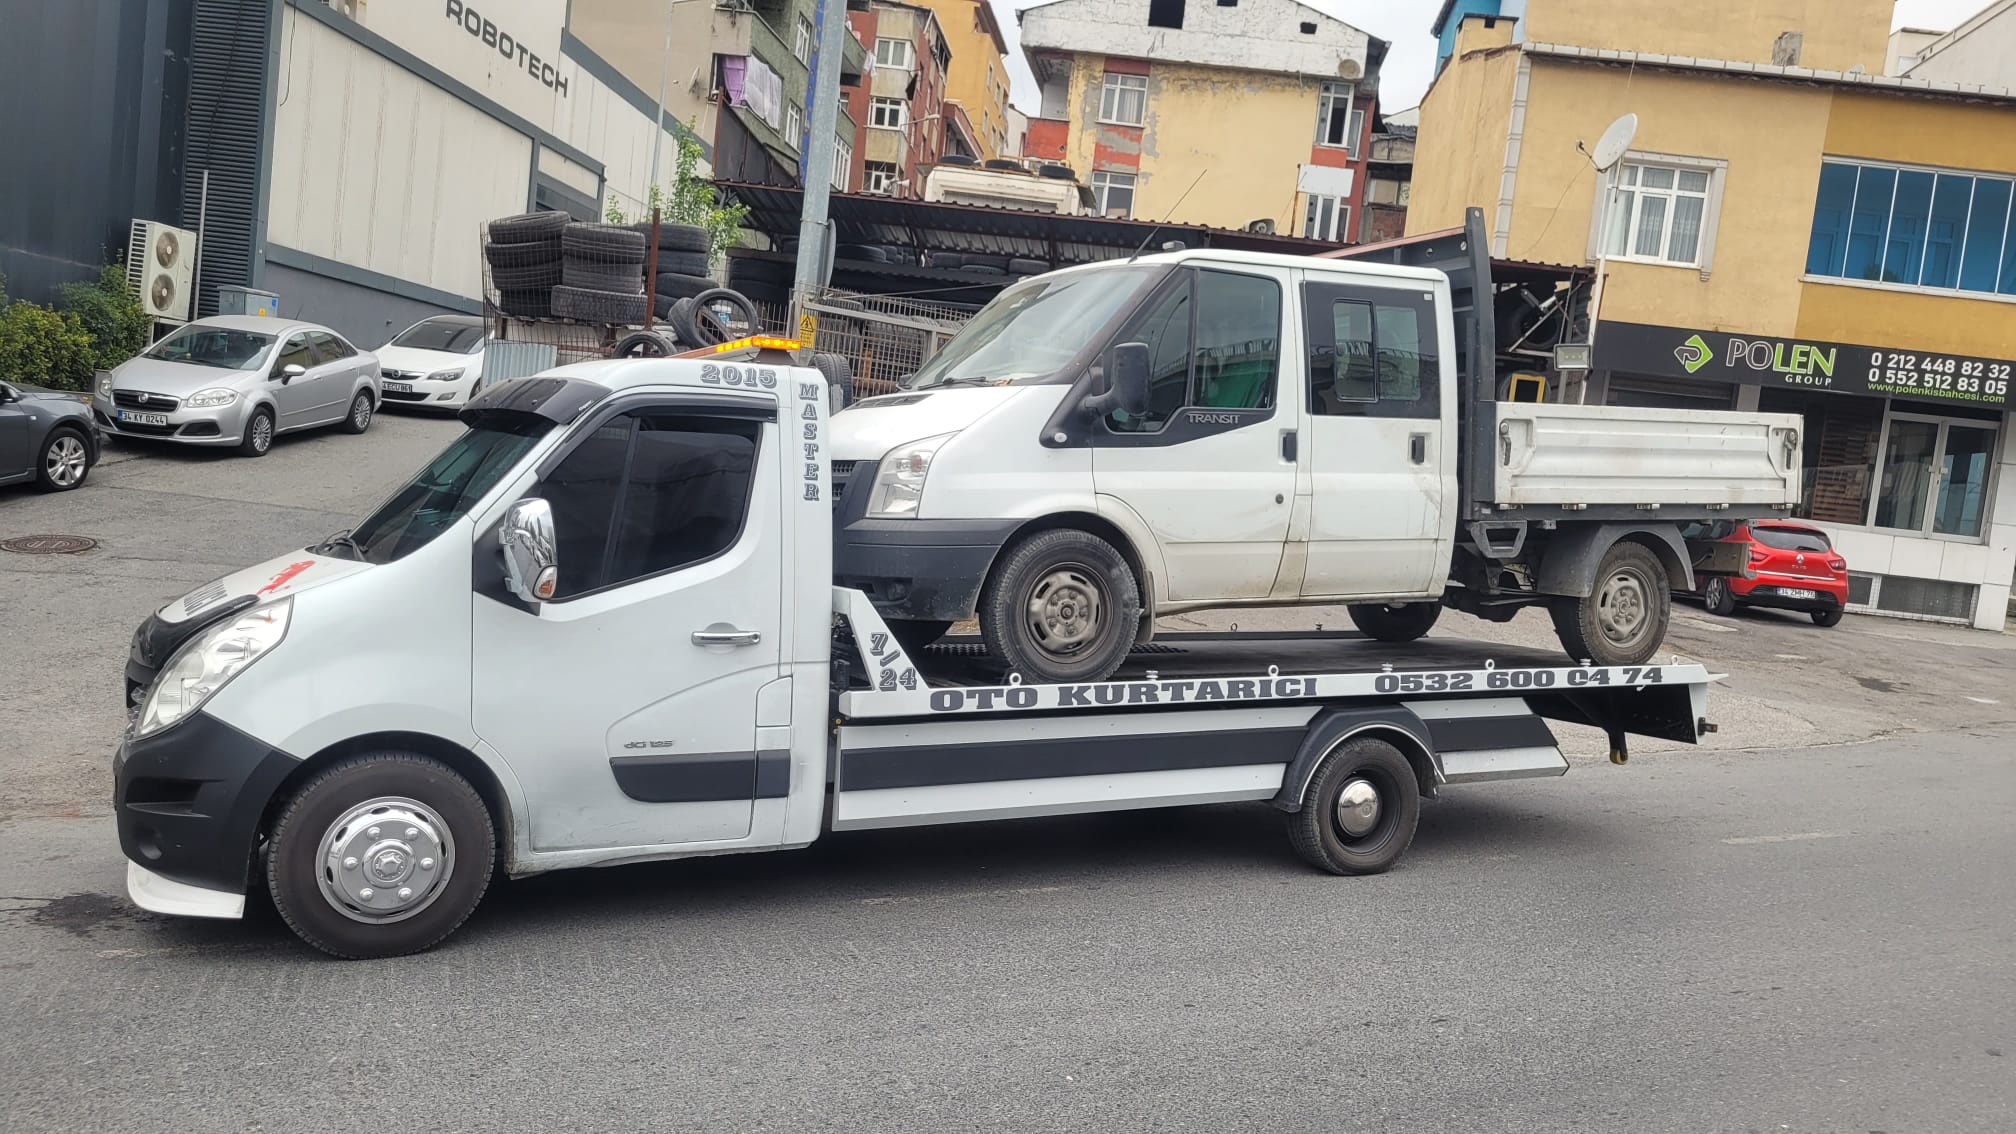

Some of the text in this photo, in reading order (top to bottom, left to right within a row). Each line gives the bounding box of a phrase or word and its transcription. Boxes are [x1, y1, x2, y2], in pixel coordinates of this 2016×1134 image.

[446, 0, 568, 98] ROBOTECH
[1725, 338, 1837, 376] POLEN
[1871, 352, 2011, 379] 0 212 448 82 32
[701, 364, 778, 389] 2015
[1785, 374, 1832, 386] GROUP
[1868, 368, 2008, 395] 0 552 512 83 05
[1867, 382, 2005, 403] www.polenkisbahcesi.com
[122, 412, 165, 425] 34 KY 0244
[1187, 413, 1240, 424] TRANSIT
[799, 383, 820, 501] MASTER
[930, 687, 1039, 712] OTO
[1375, 672, 1473, 693] 0532
[1487, 670, 1555, 689] 600
[1567, 669, 1610, 687] 04
[1622, 667, 1663, 684] 74
